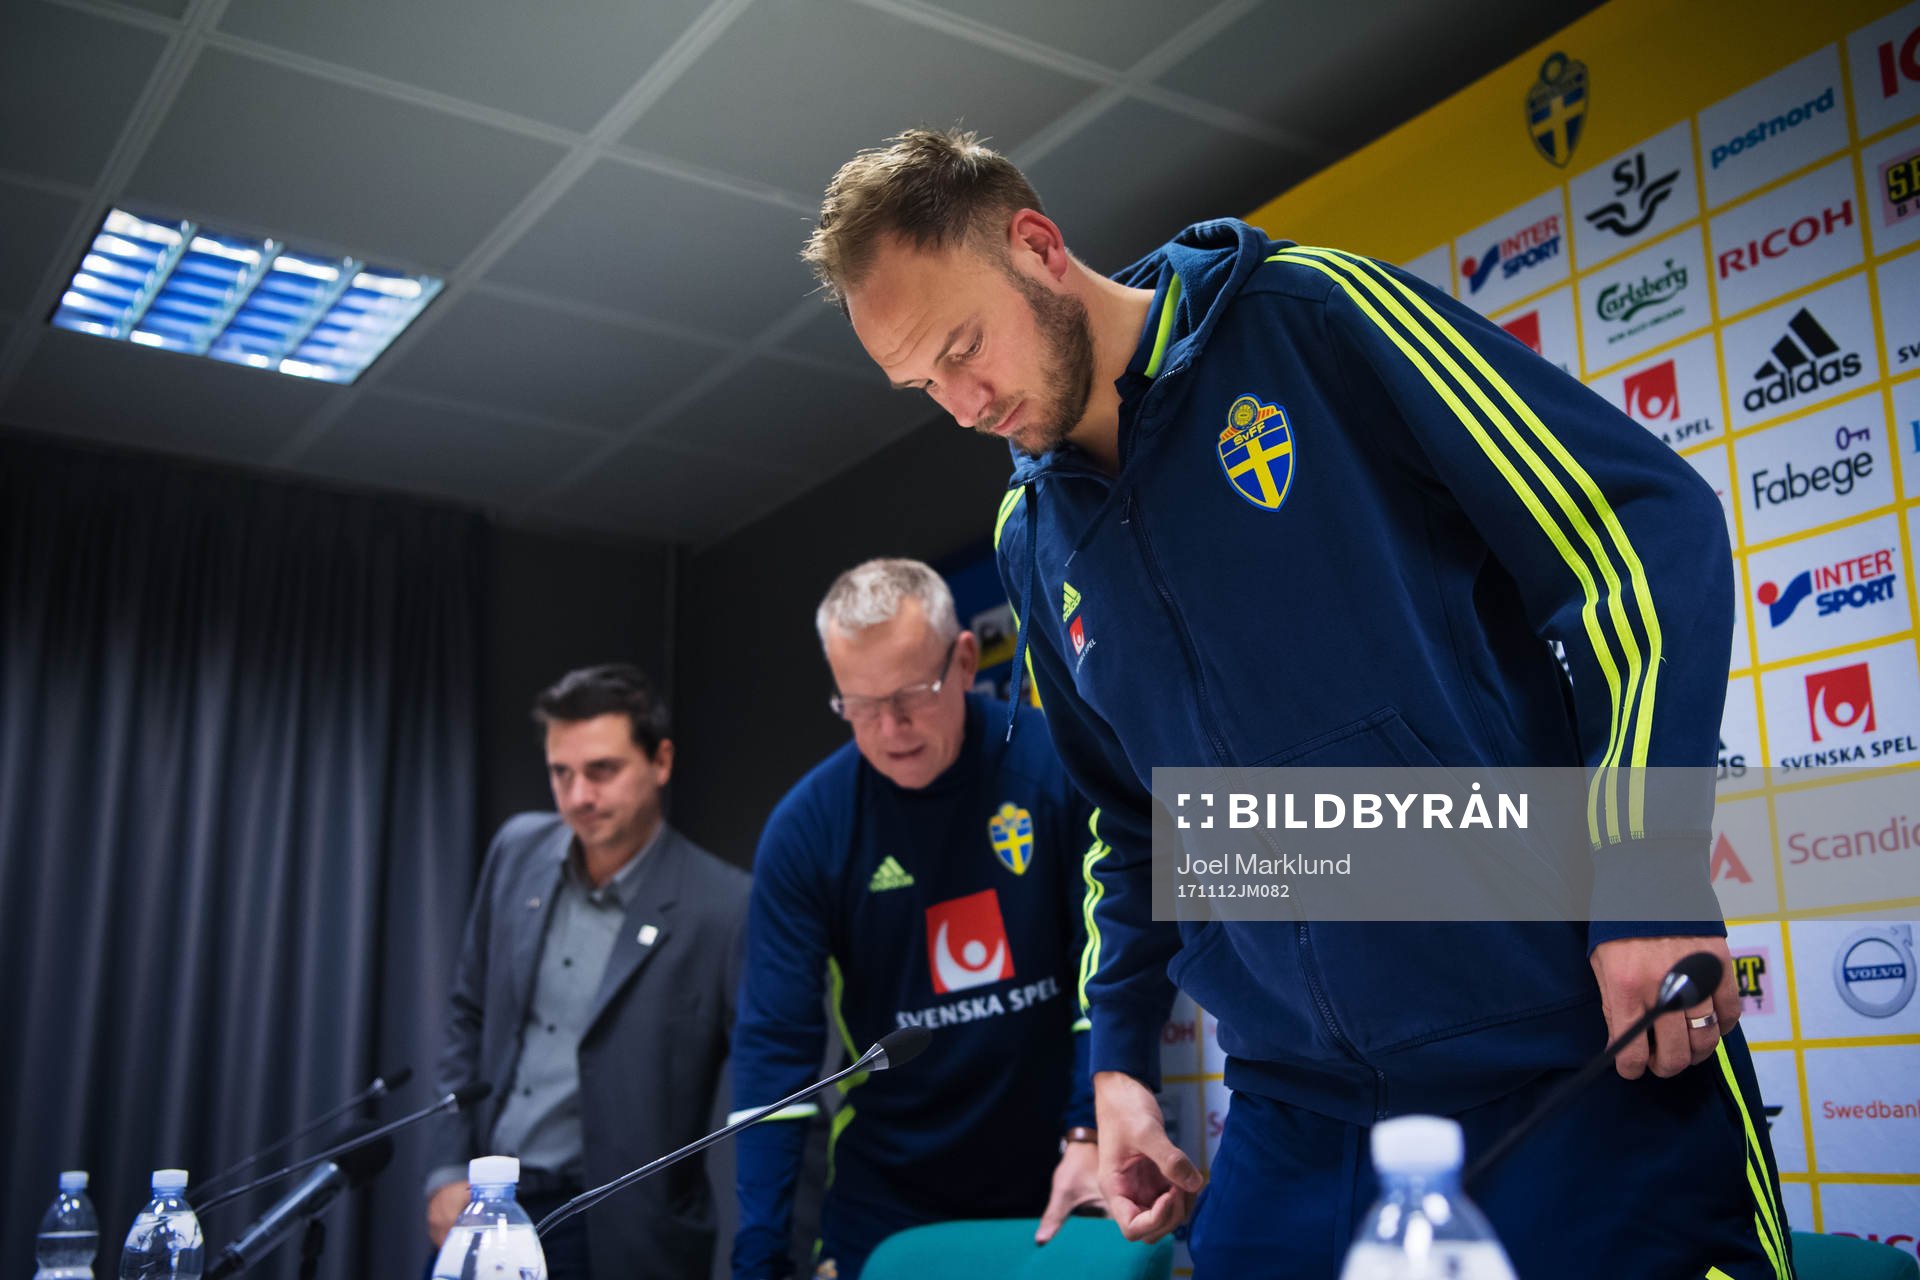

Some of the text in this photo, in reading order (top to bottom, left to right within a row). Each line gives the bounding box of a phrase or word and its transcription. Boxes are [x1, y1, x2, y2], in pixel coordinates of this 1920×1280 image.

[1711, 86, 1834, 169] postnord
[1612, 152, 1646, 197] SJ
[1500, 215, 1560, 258] INTER
[1503, 236, 1561, 279] SPORT
[1718, 199, 1854, 280] RICOH
[1597, 263, 1688, 321] Carlsberg
[1743, 351, 1862, 412] adidas
[1233, 421, 1265, 446] SvFF
[1676, 418, 1714, 442] SPEL
[1752, 452, 1873, 510] Fabege
[1815, 549, 1893, 591] INTER
[1816, 575, 1896, 616] SPORT
[1780, 736, 1918, 774] SVENSKA SPEL
[1847, 966, 1904, 980] VOLVO
[896, 977, 1061, 1029] SVENSKA SPEL
